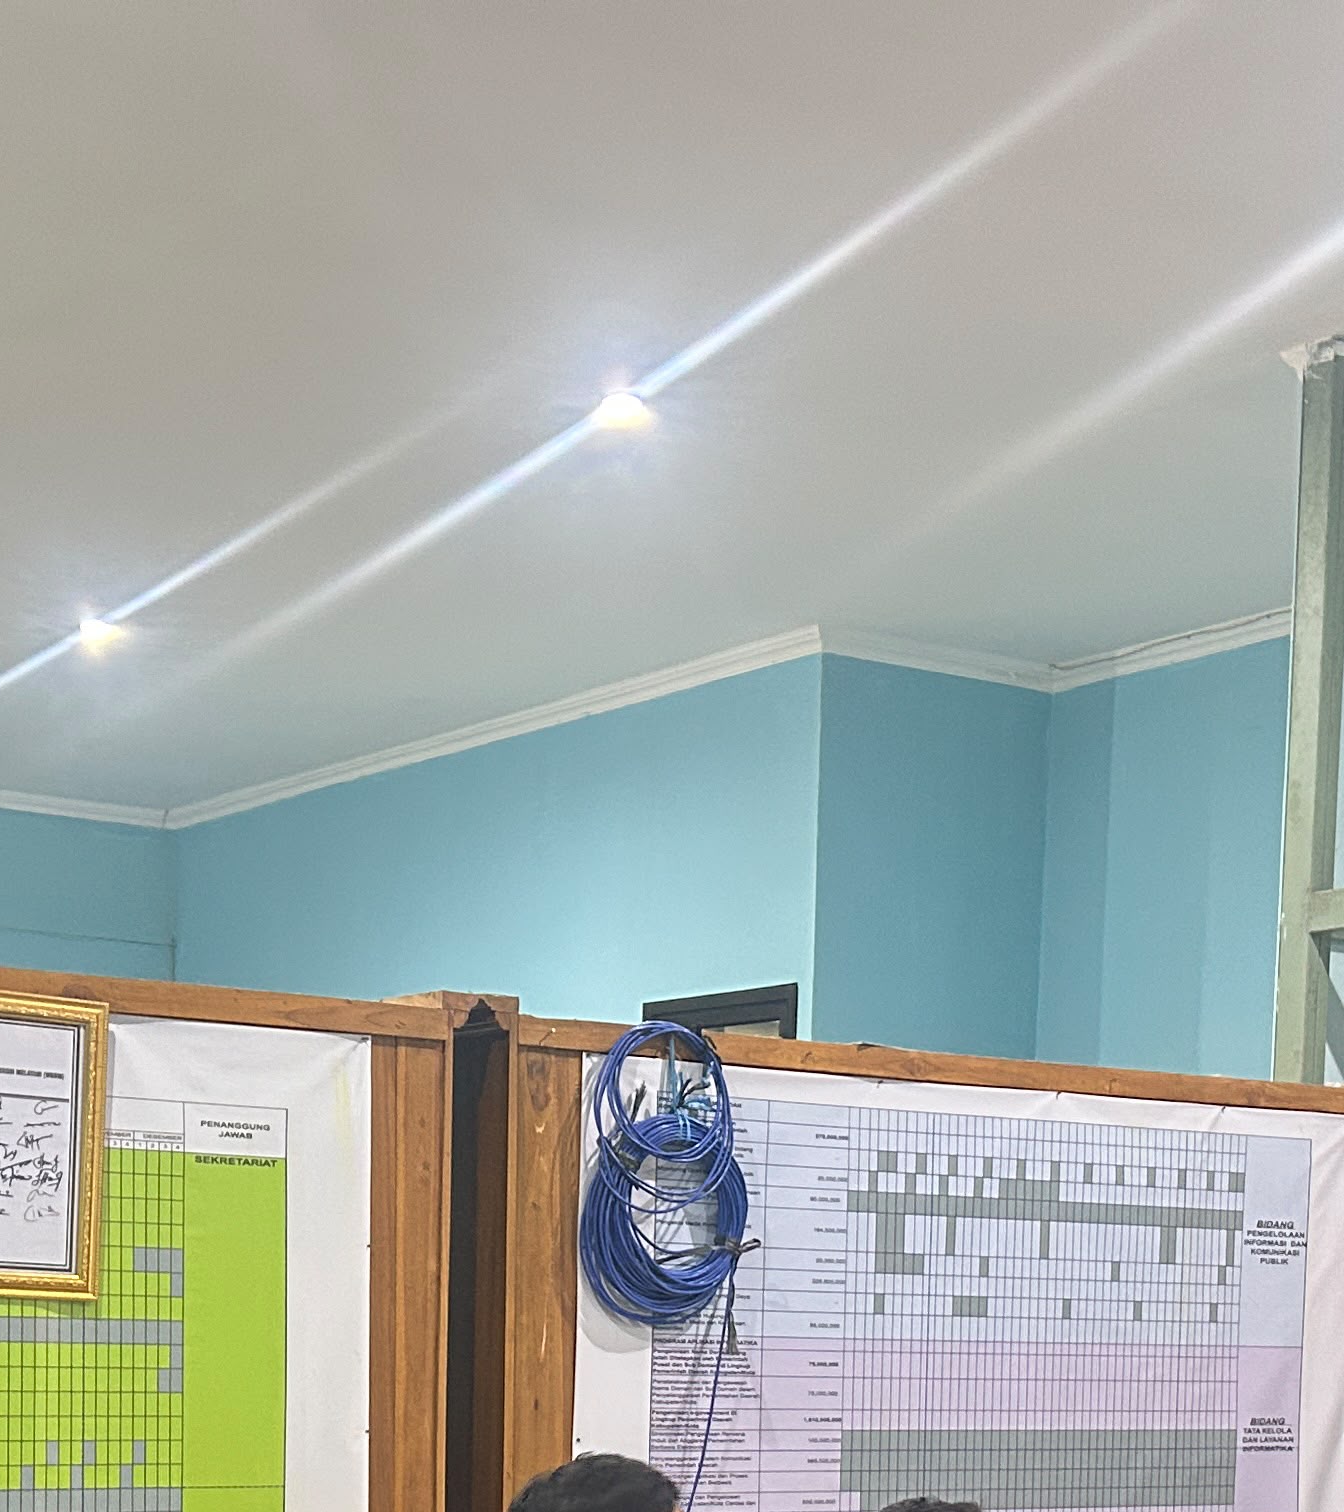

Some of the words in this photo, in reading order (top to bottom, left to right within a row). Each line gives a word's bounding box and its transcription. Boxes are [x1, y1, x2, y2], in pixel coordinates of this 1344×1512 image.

[200, 1119, 271, 1131] PENANGGUNG
[218, 1130, 253, 1139] JAWAB
[195, 1155, 278, 1168] SEKRETARIAT
[1256, 1220, 1294, 1230] BIDANG
[1250, 1417, 1285, 1426] BIDANG
